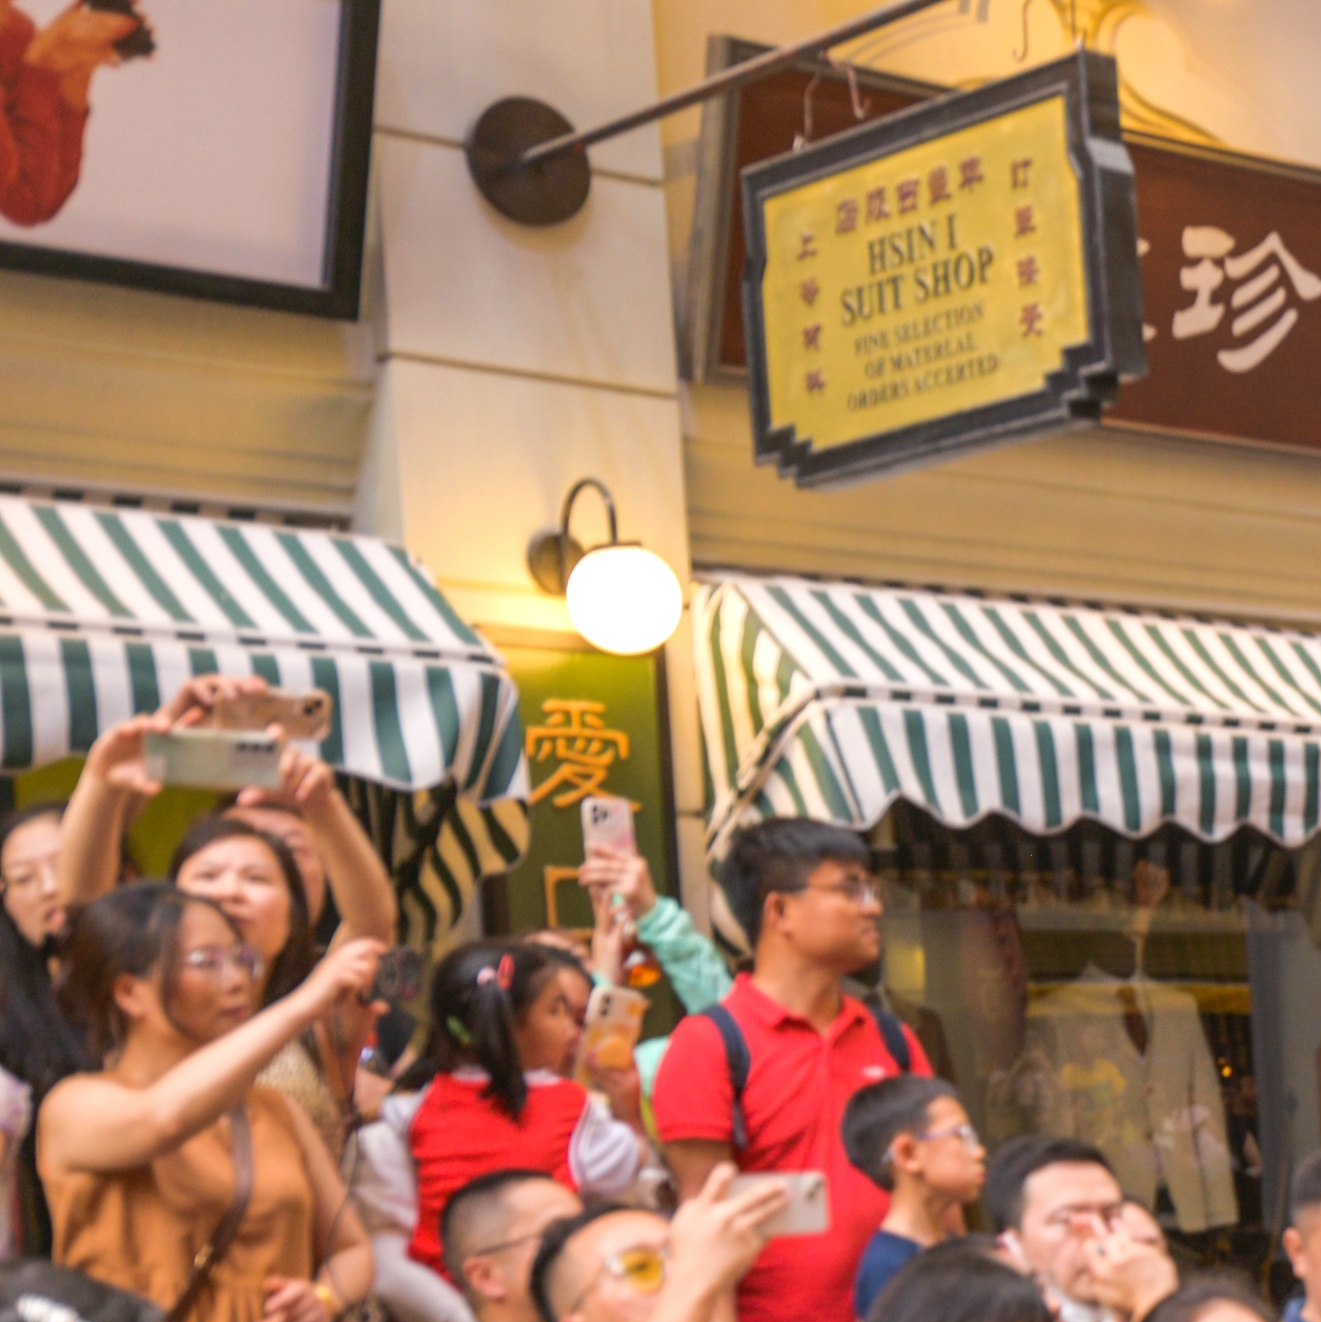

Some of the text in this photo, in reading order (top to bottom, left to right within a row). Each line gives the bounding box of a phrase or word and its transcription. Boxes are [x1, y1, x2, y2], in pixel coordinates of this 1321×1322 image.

[868, 213, 959, 275] HSIN I
[841, 246, 995, 327] SUIT SHOP
